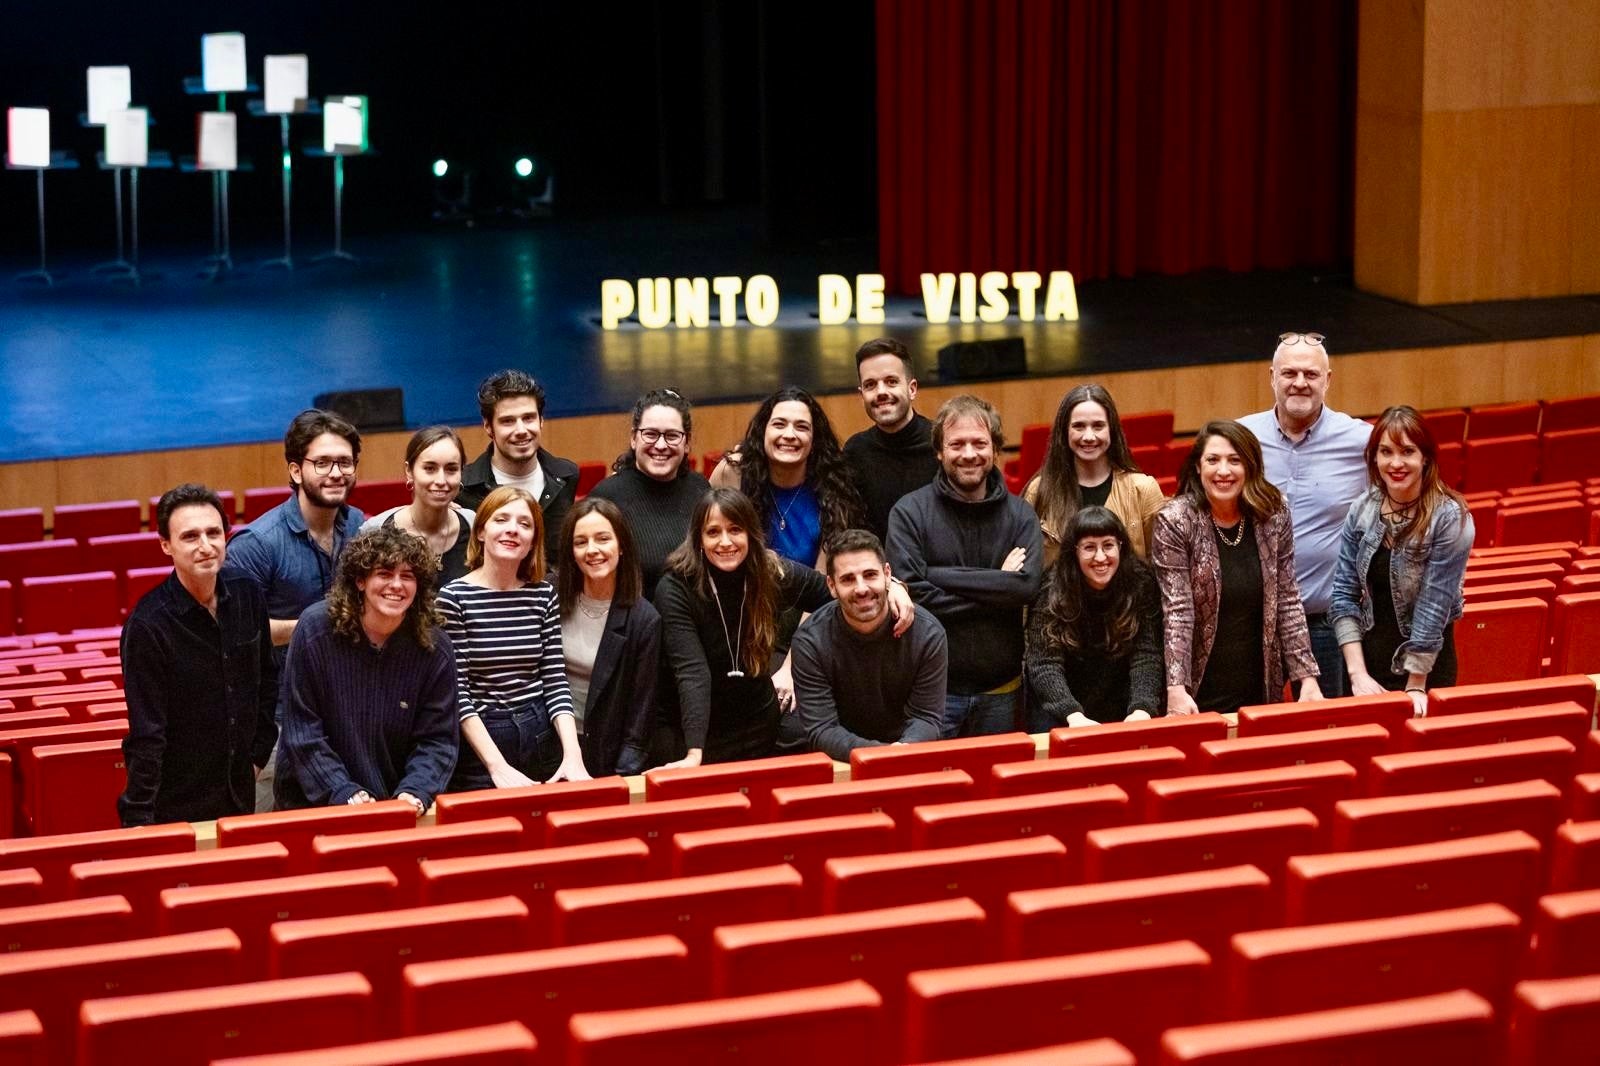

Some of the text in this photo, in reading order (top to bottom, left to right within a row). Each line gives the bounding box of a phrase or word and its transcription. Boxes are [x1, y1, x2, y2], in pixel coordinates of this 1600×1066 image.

[601, 271, 1079, 330] PUNTO DE VISTA
